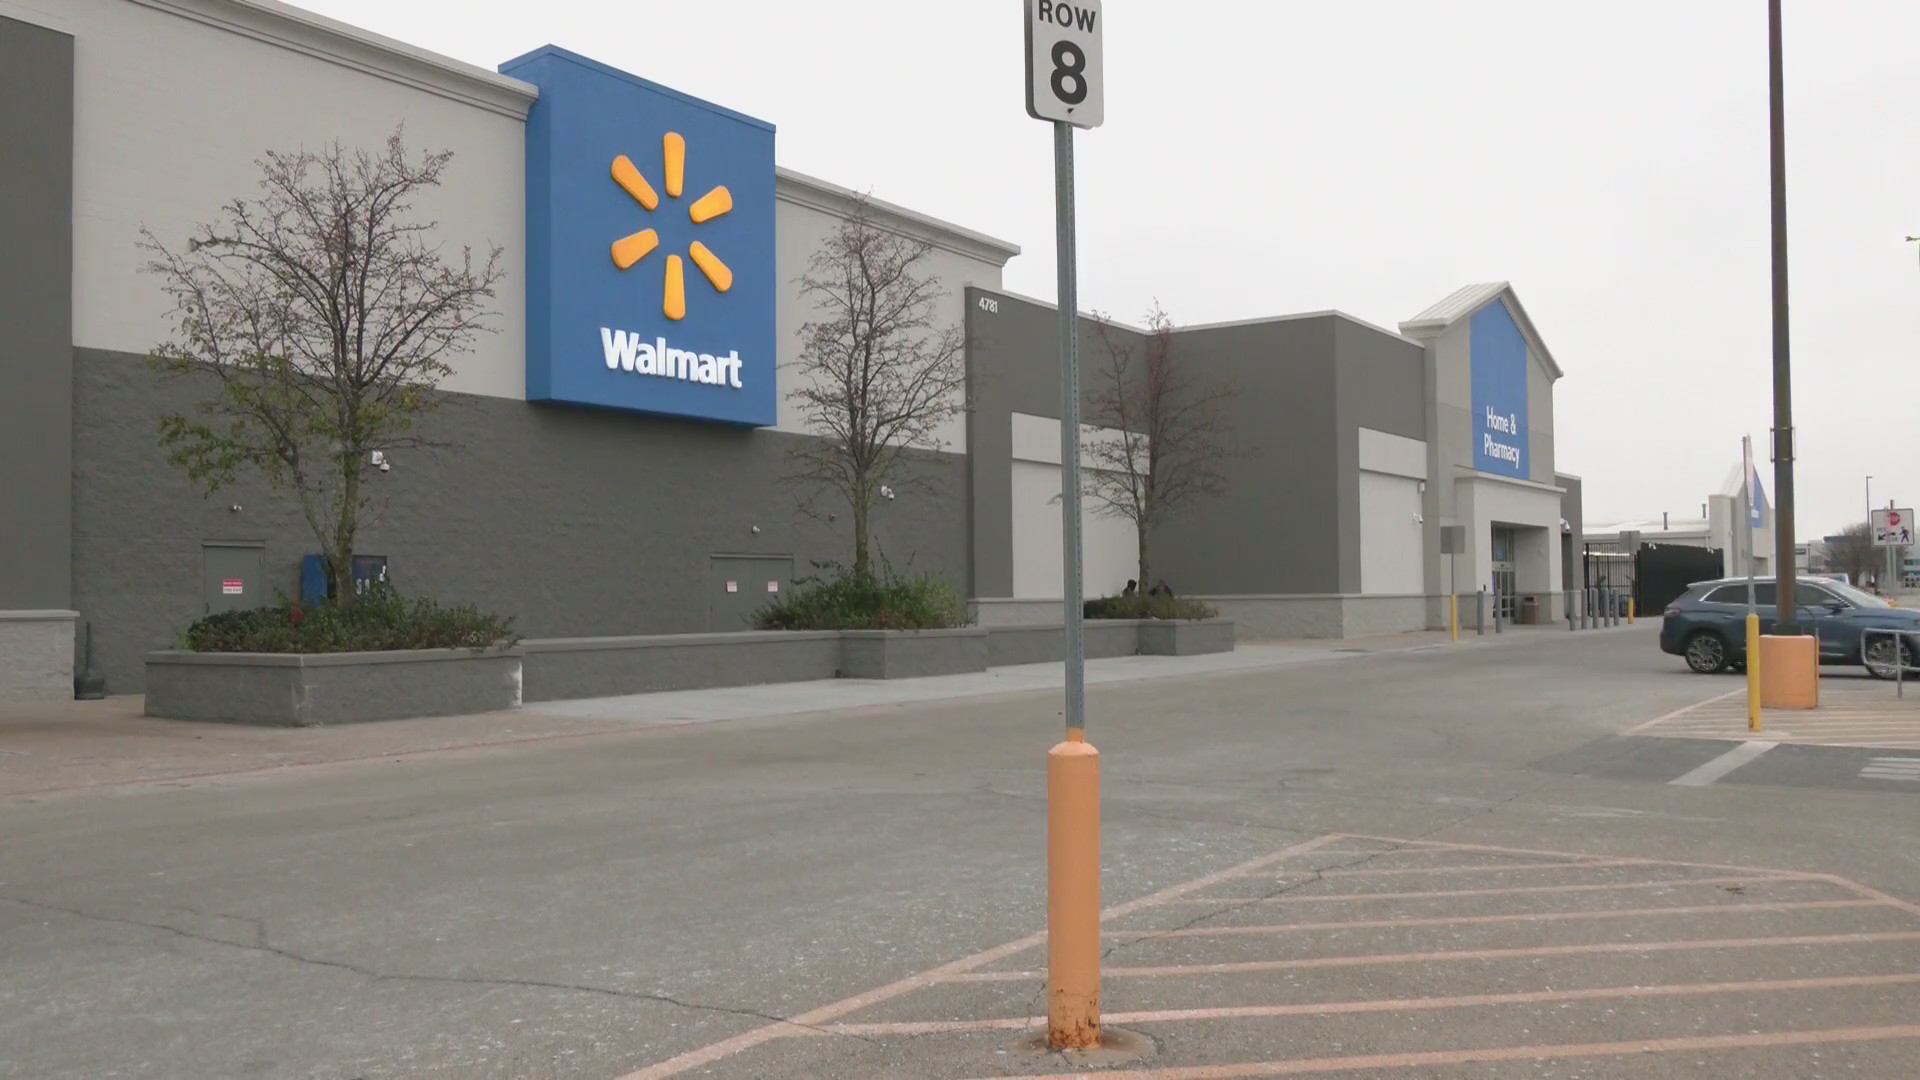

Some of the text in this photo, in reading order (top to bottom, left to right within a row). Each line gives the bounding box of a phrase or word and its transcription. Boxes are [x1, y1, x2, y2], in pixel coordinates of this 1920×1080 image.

[1039, 0, 1096, 33] ROW
[1051, 40, 1087, 105] 8
[978, 297, 998, 313] 4781
[600, 327, 743, 388] Walmart
[1486, 405, 1517, 435] Home &
[1484, 433, 1520, 469] Pharmacy
